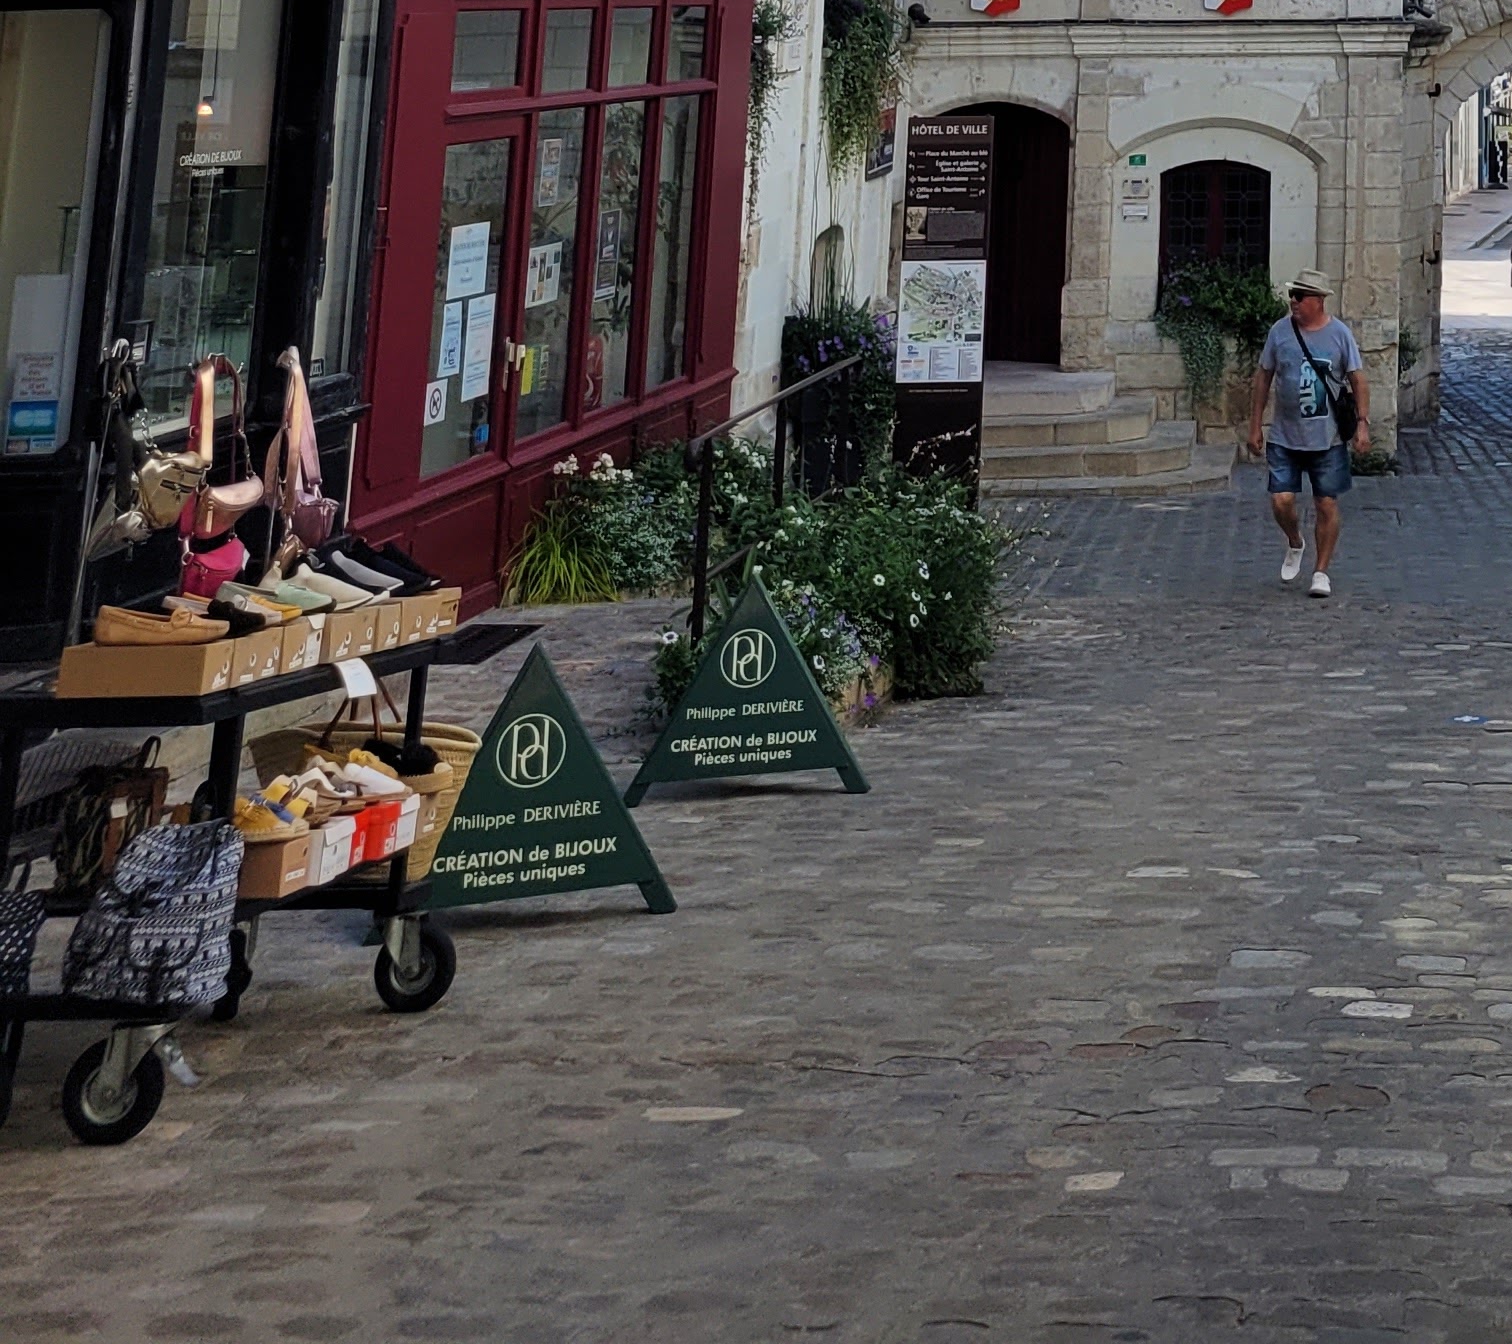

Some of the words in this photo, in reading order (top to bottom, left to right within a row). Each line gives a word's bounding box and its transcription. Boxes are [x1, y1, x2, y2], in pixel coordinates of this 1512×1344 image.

[911, 124, 944, 135] HÔTEL
[946, 125, 960, 135] DE
[962, 124, 988, 135] VILLE
[686, 706, 737, 721] Philippe
[742, 698, 804, 716] DERIVIÈRE
[670, 734, 742, 753] CRÉATION
[746, 733, 763, 747] de
[767, 729, 818, 746] BIJOUX
[694, 752, 735, 766] Pièces
[739, 748, 792, 764] uniques
[453, 812, 516, 832] Philippe
[432, 847, 523, 873] CRÉATION
[528, 845, 550, 862] de
[555, 836, 617, 859] BIJOUX
[463, 871, 514, 889] Pièces
[520, 863, 586, 882] uniques
